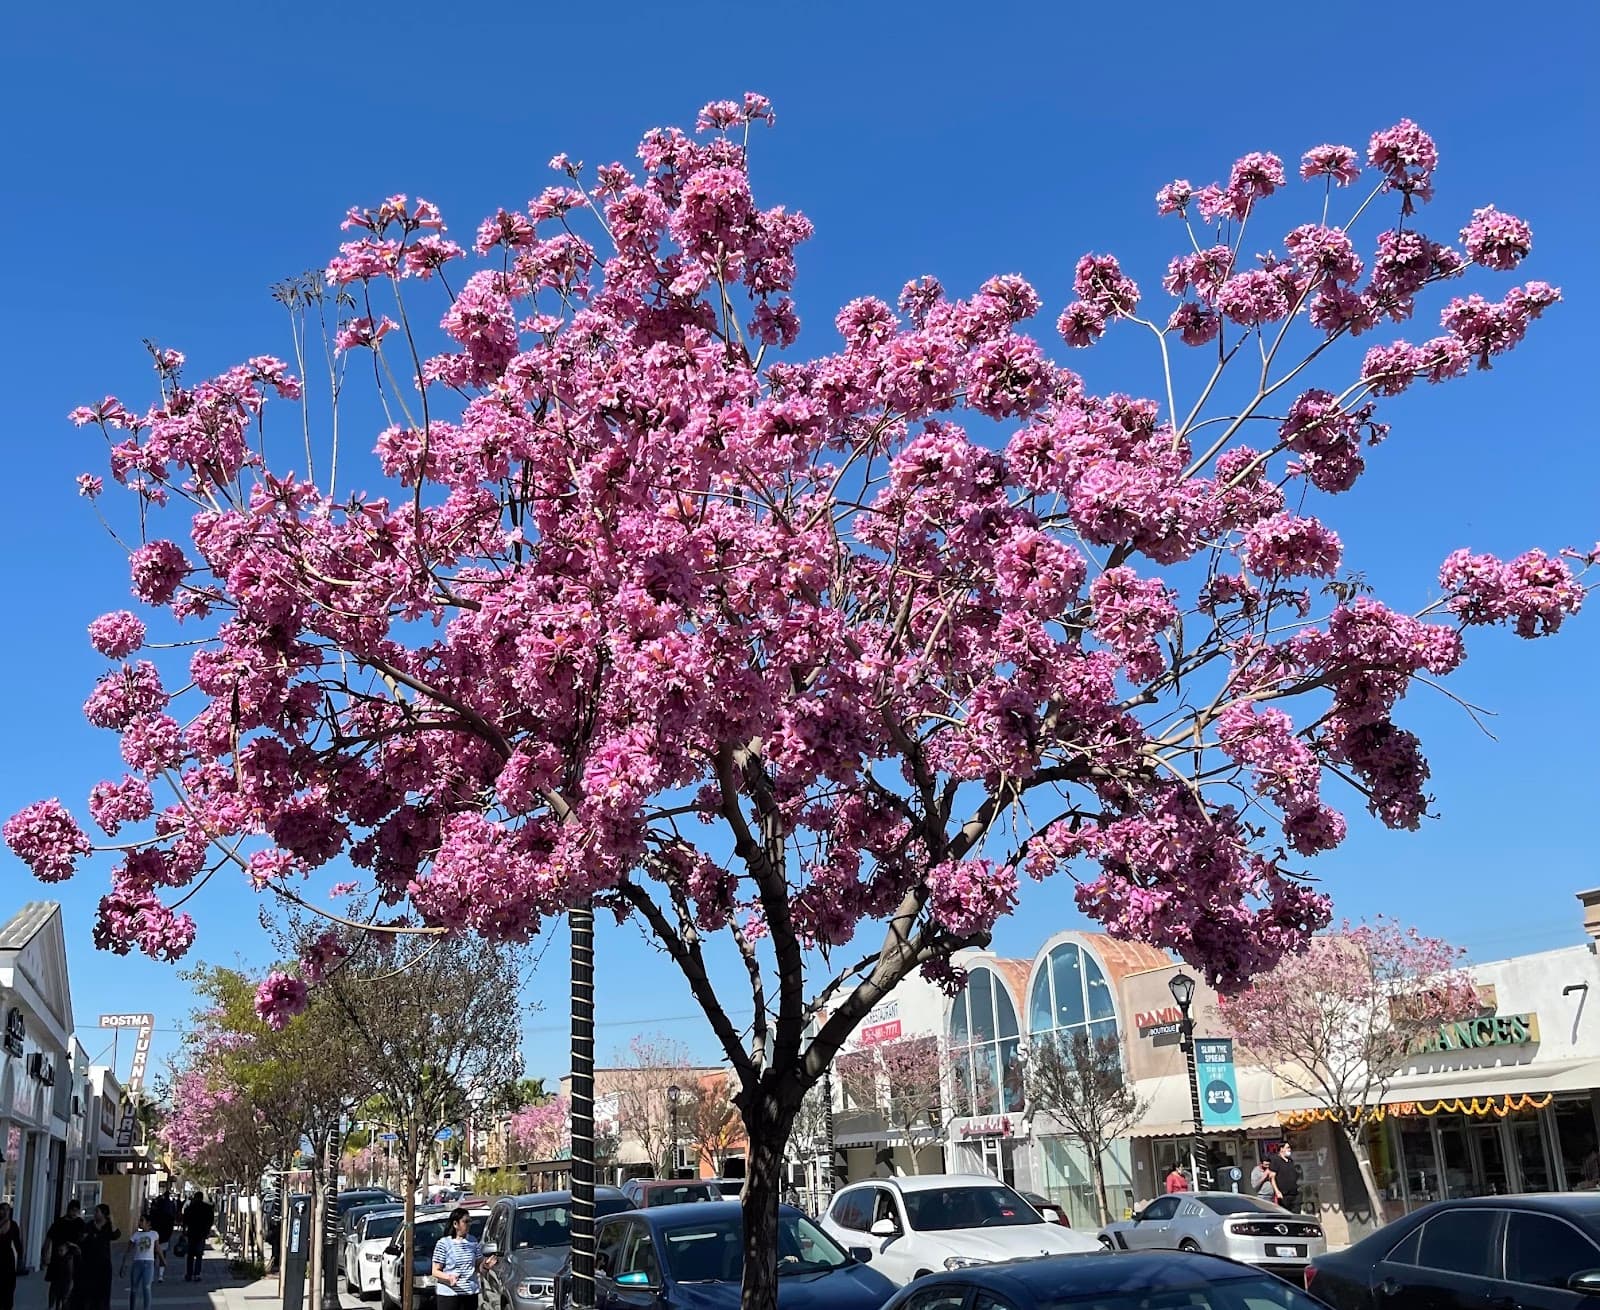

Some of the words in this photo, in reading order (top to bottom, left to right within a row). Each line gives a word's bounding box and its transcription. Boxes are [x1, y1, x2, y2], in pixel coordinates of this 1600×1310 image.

[101, 1015, 149, 1026] POSTMA
[1150, 1024, 1176, 1036] BOUTIQUE
[1424, 1015, 1529, 1052] ANCES
[1201, 1045, 1217, 1054] SLOW
[1217, 1045, 1228, 1053] THE
[1205, 1054, 1226, 1063] SPREAD
[118, 1026, 151, 1144] FURNITURE
